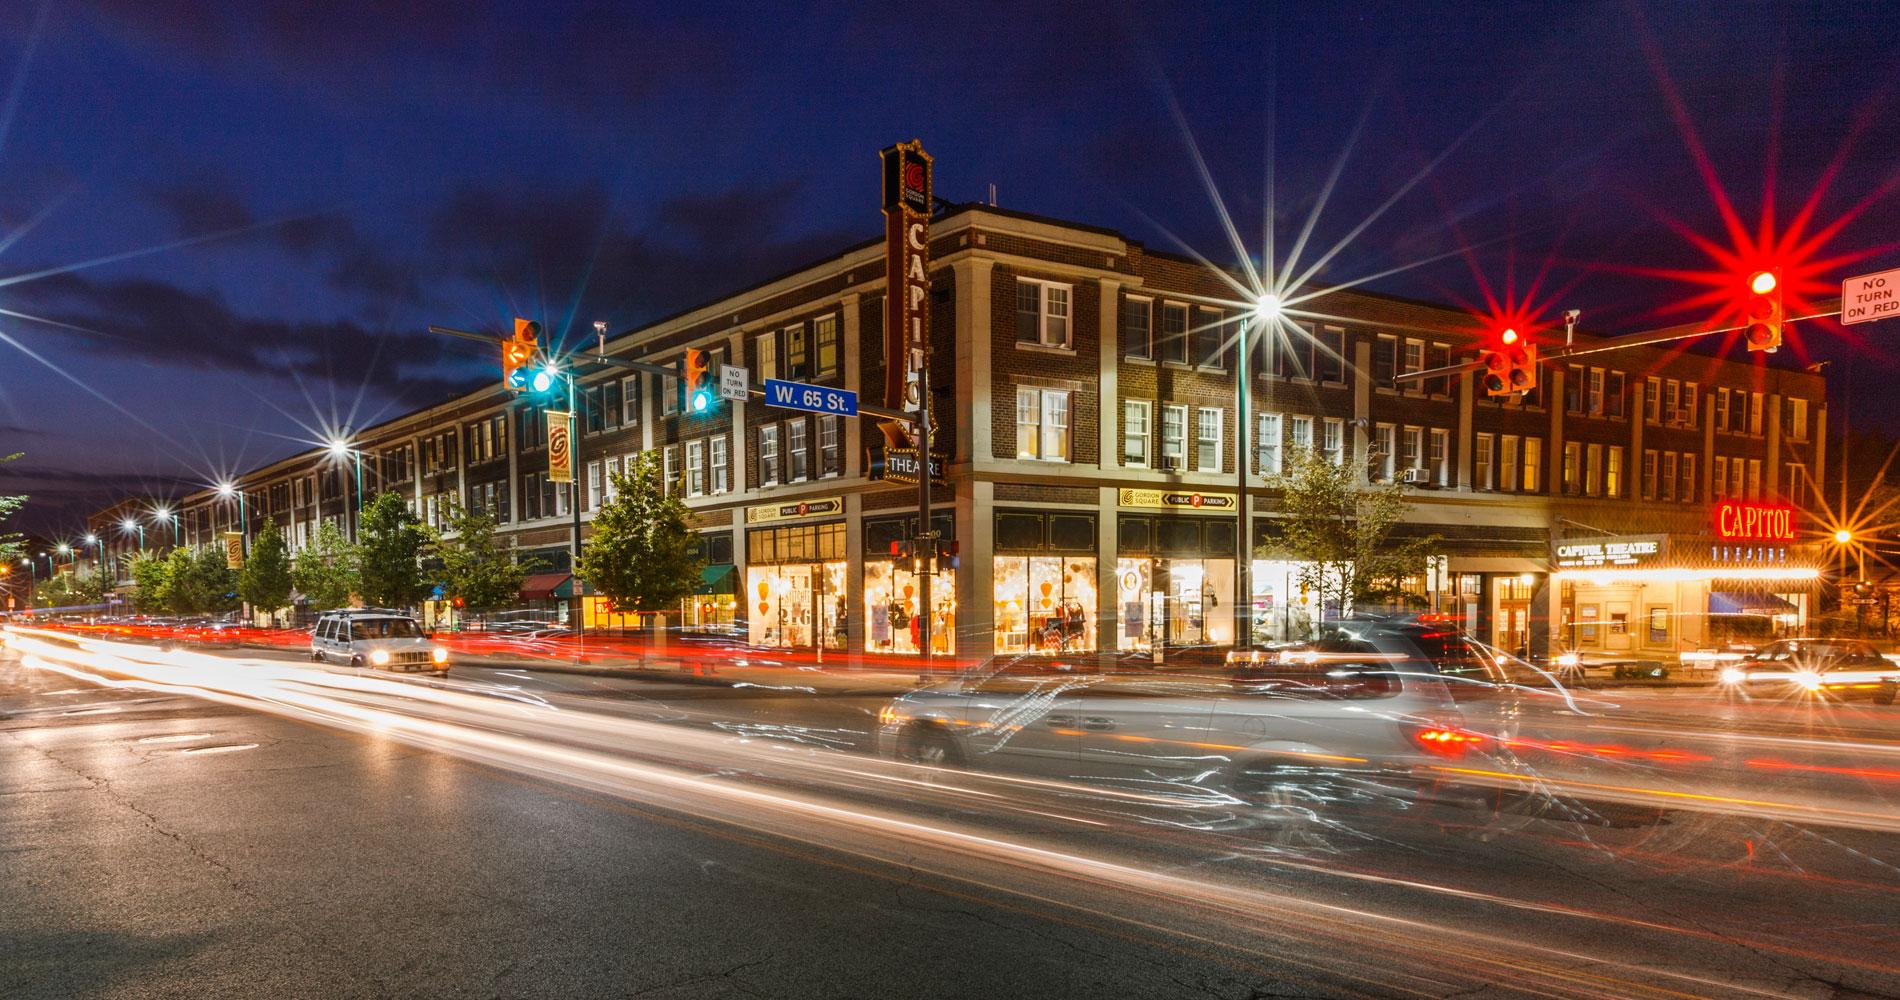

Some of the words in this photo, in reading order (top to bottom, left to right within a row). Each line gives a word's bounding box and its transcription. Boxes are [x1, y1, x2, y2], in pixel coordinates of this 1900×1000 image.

[1863, 278, 1886, 290] NO
[1856, 290, 1893, 303] TURN
[1848, 307, 1866, 318] ON
[1873, 301, 1900, 313] RED
[729, 370, 740, 378] NO
[726, 379, 743, 387] TURN
[734, 390, 746, 398] RED
[775, 385, 798, 405] W.
[803, 390, 822, 408] 65
[827, 393, 849, 412] St.
[890, 457, 941, 476] THEARE
[808, 503, 829, 511] PARKING
[1203, 497, 1226, 505] PARKING
[1721, 505, 1794, 539] CAPITOL
[1557, 545, 1604, 557] CAPITOL
[1605, 542, 1658, 555] THEATRE
